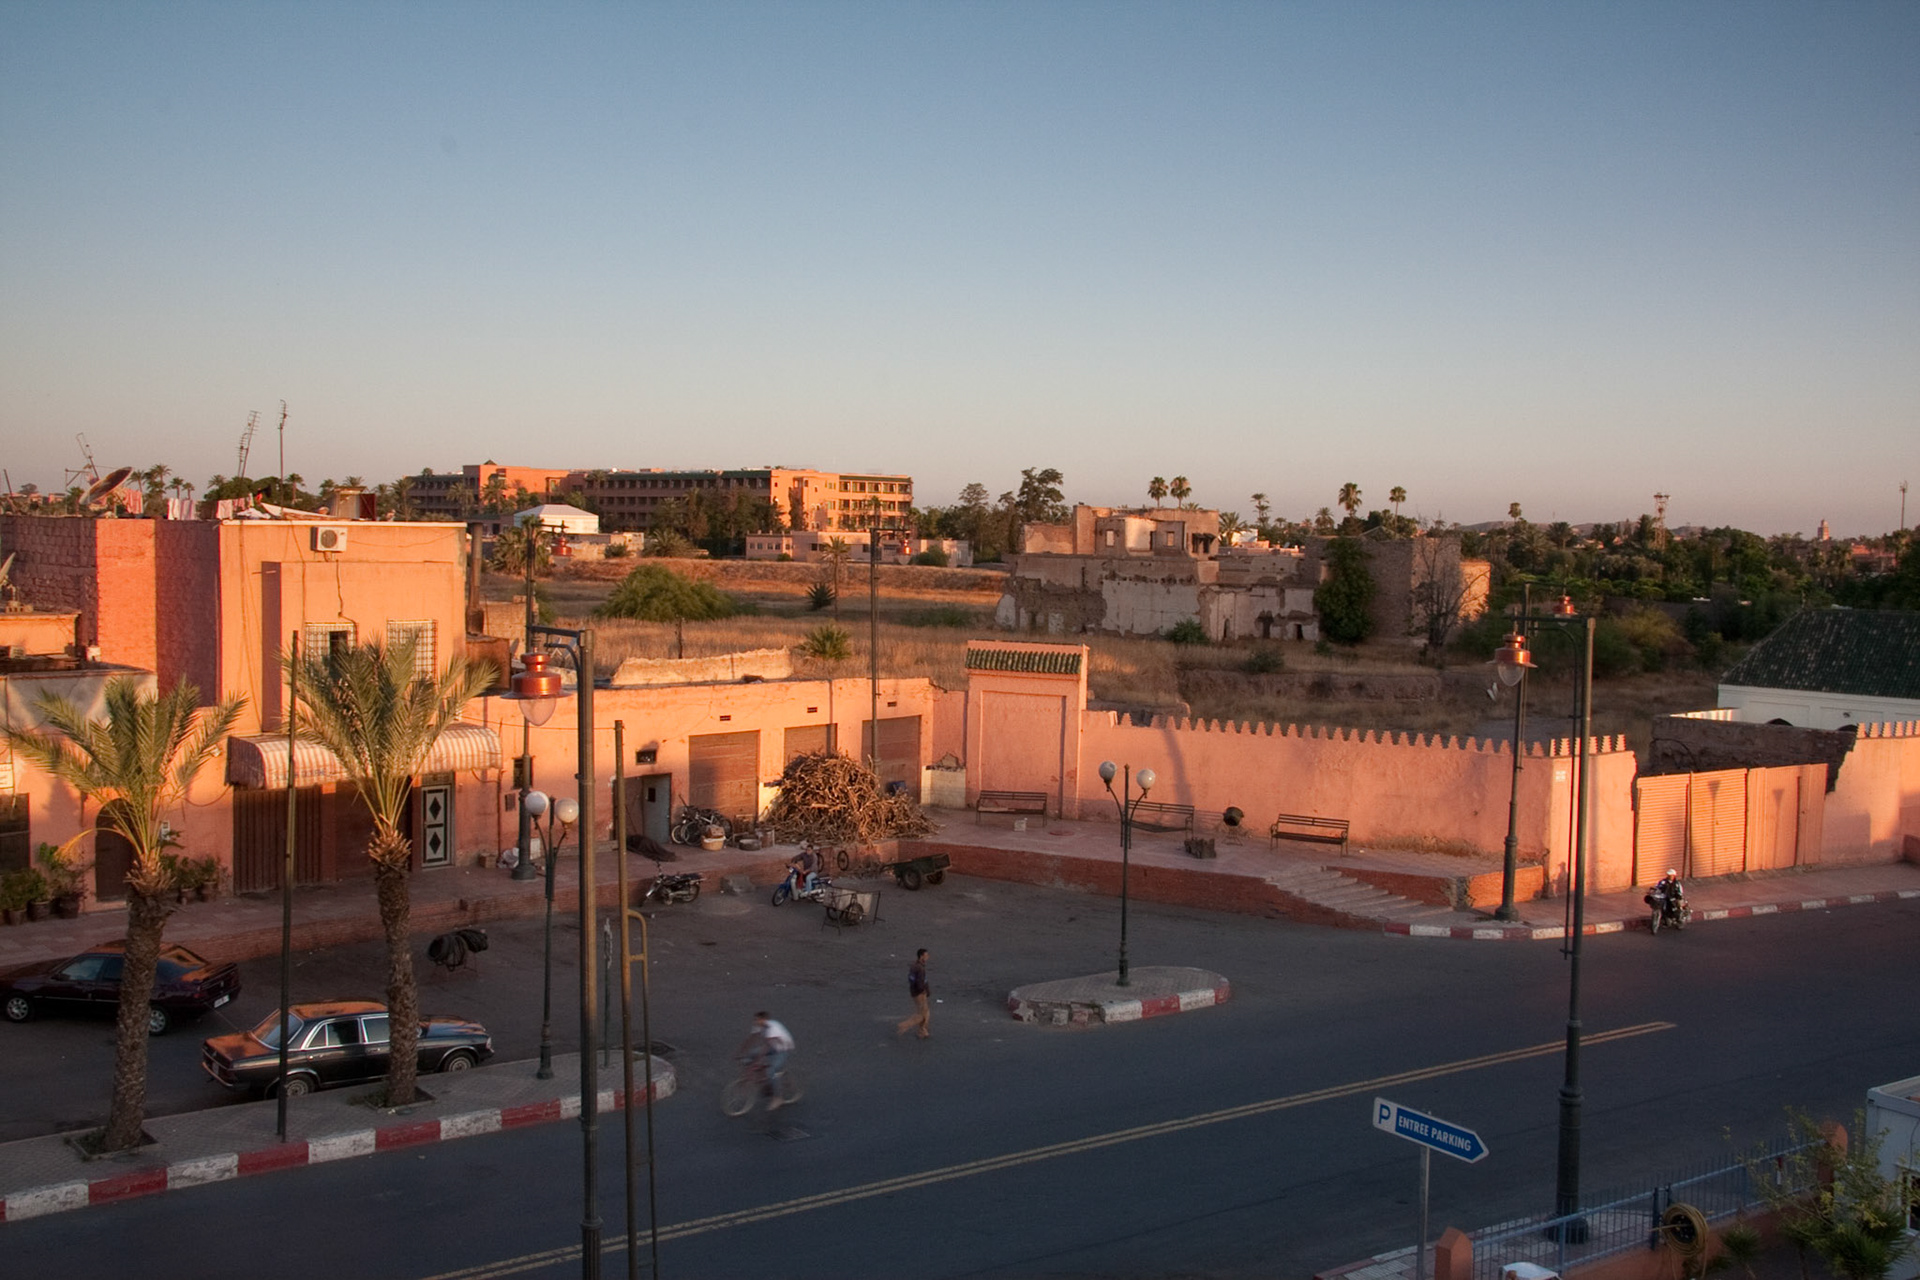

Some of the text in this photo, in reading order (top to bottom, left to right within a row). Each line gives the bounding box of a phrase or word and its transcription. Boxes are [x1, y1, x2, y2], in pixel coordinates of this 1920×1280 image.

[1379, 1104, 1472, 1151] P ENTREE PARKING
